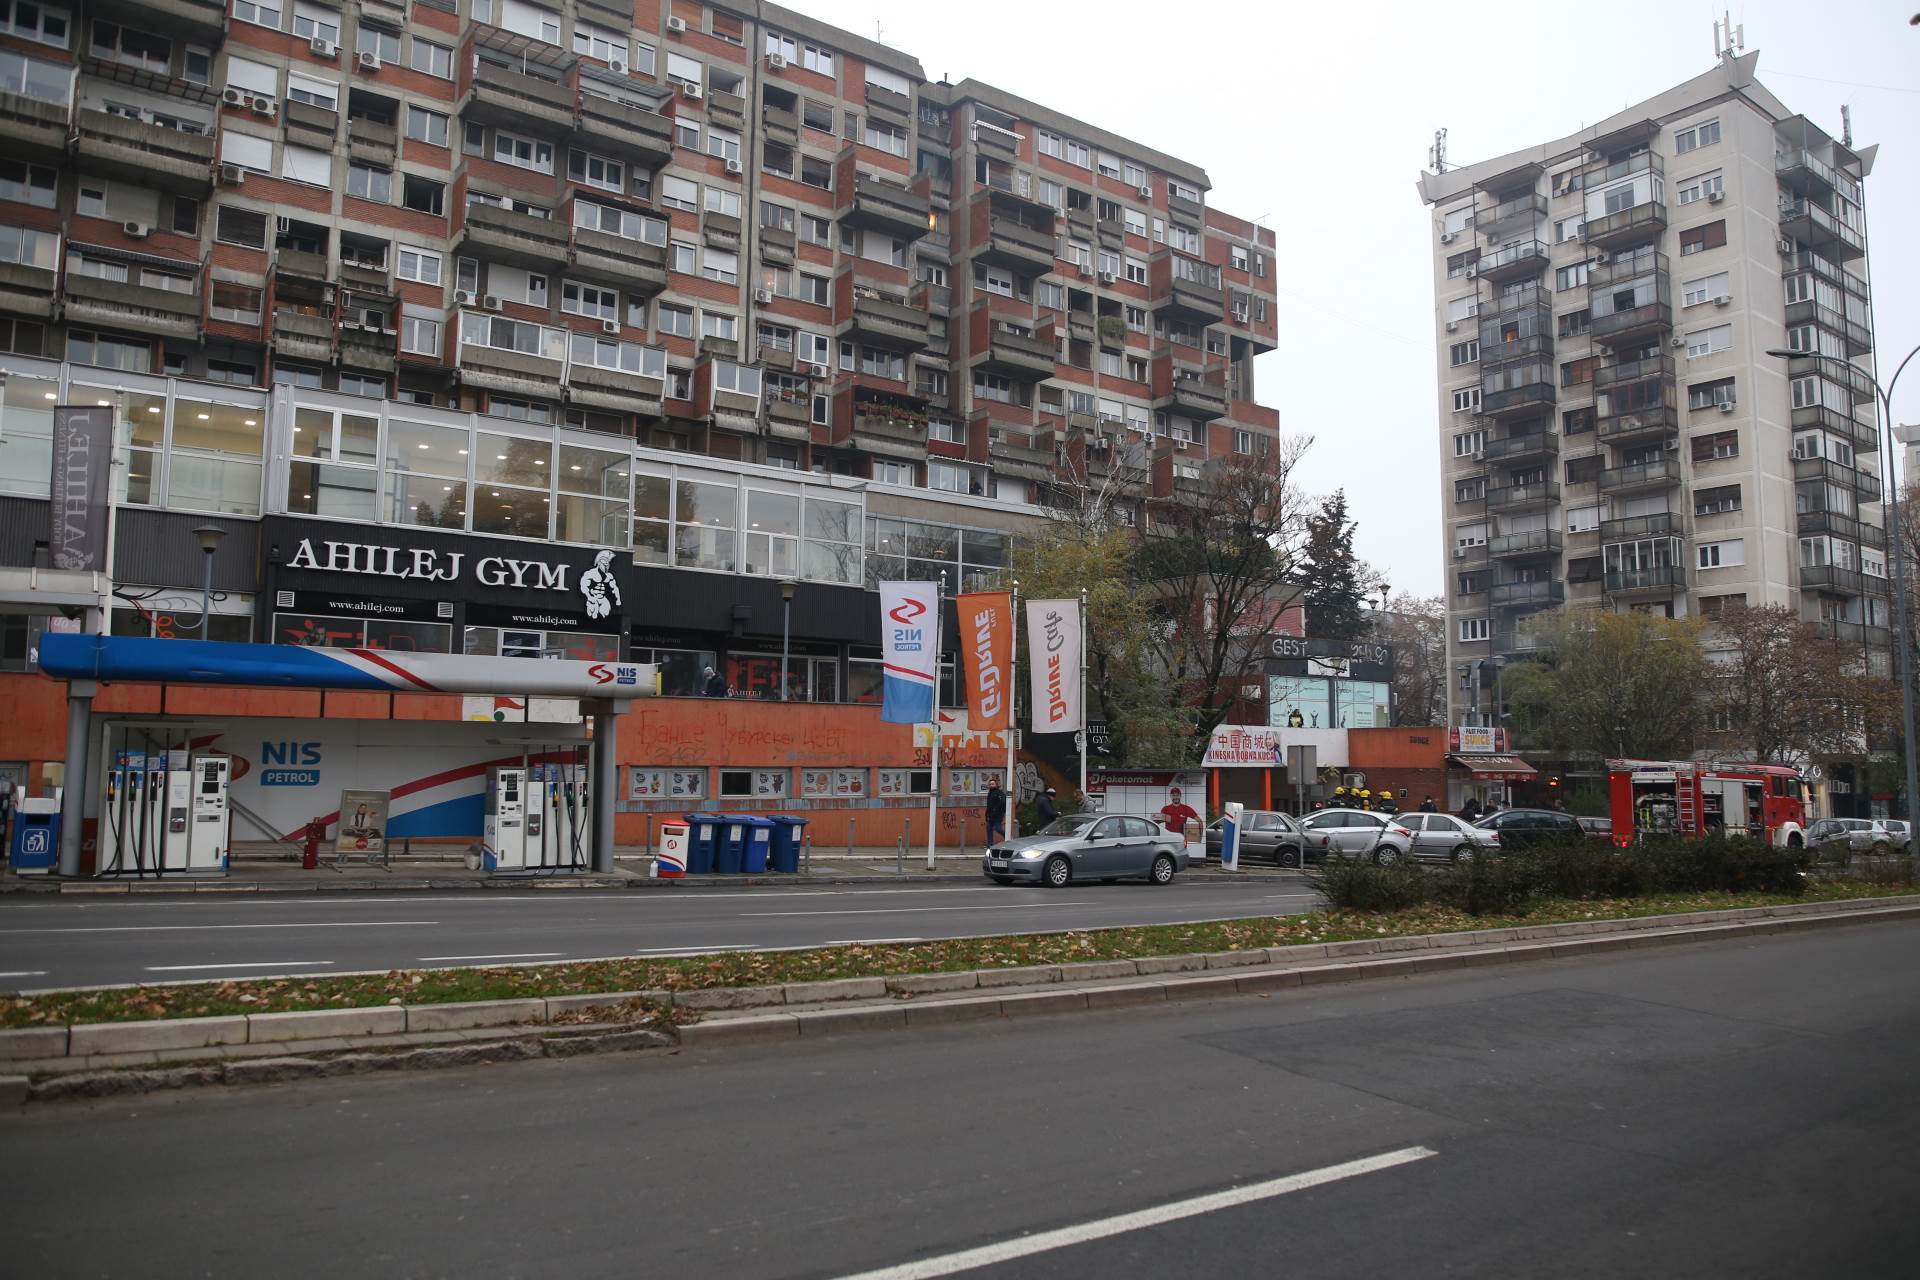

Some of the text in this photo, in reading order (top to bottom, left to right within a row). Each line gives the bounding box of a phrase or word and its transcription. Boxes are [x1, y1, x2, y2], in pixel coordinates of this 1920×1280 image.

[286, 538, 571, 591] AHILEJ GYM
[328, 600, 404, 614] www.ahilej.com
[511, 614, 577, 626] www.ahilej.com
[617, 667, 636, 677] NIS
[1218, 733, 1265, 749] 中国商城
[262, 741, 321, 765] NIS
[267, 772, 314, 783] PETROL
